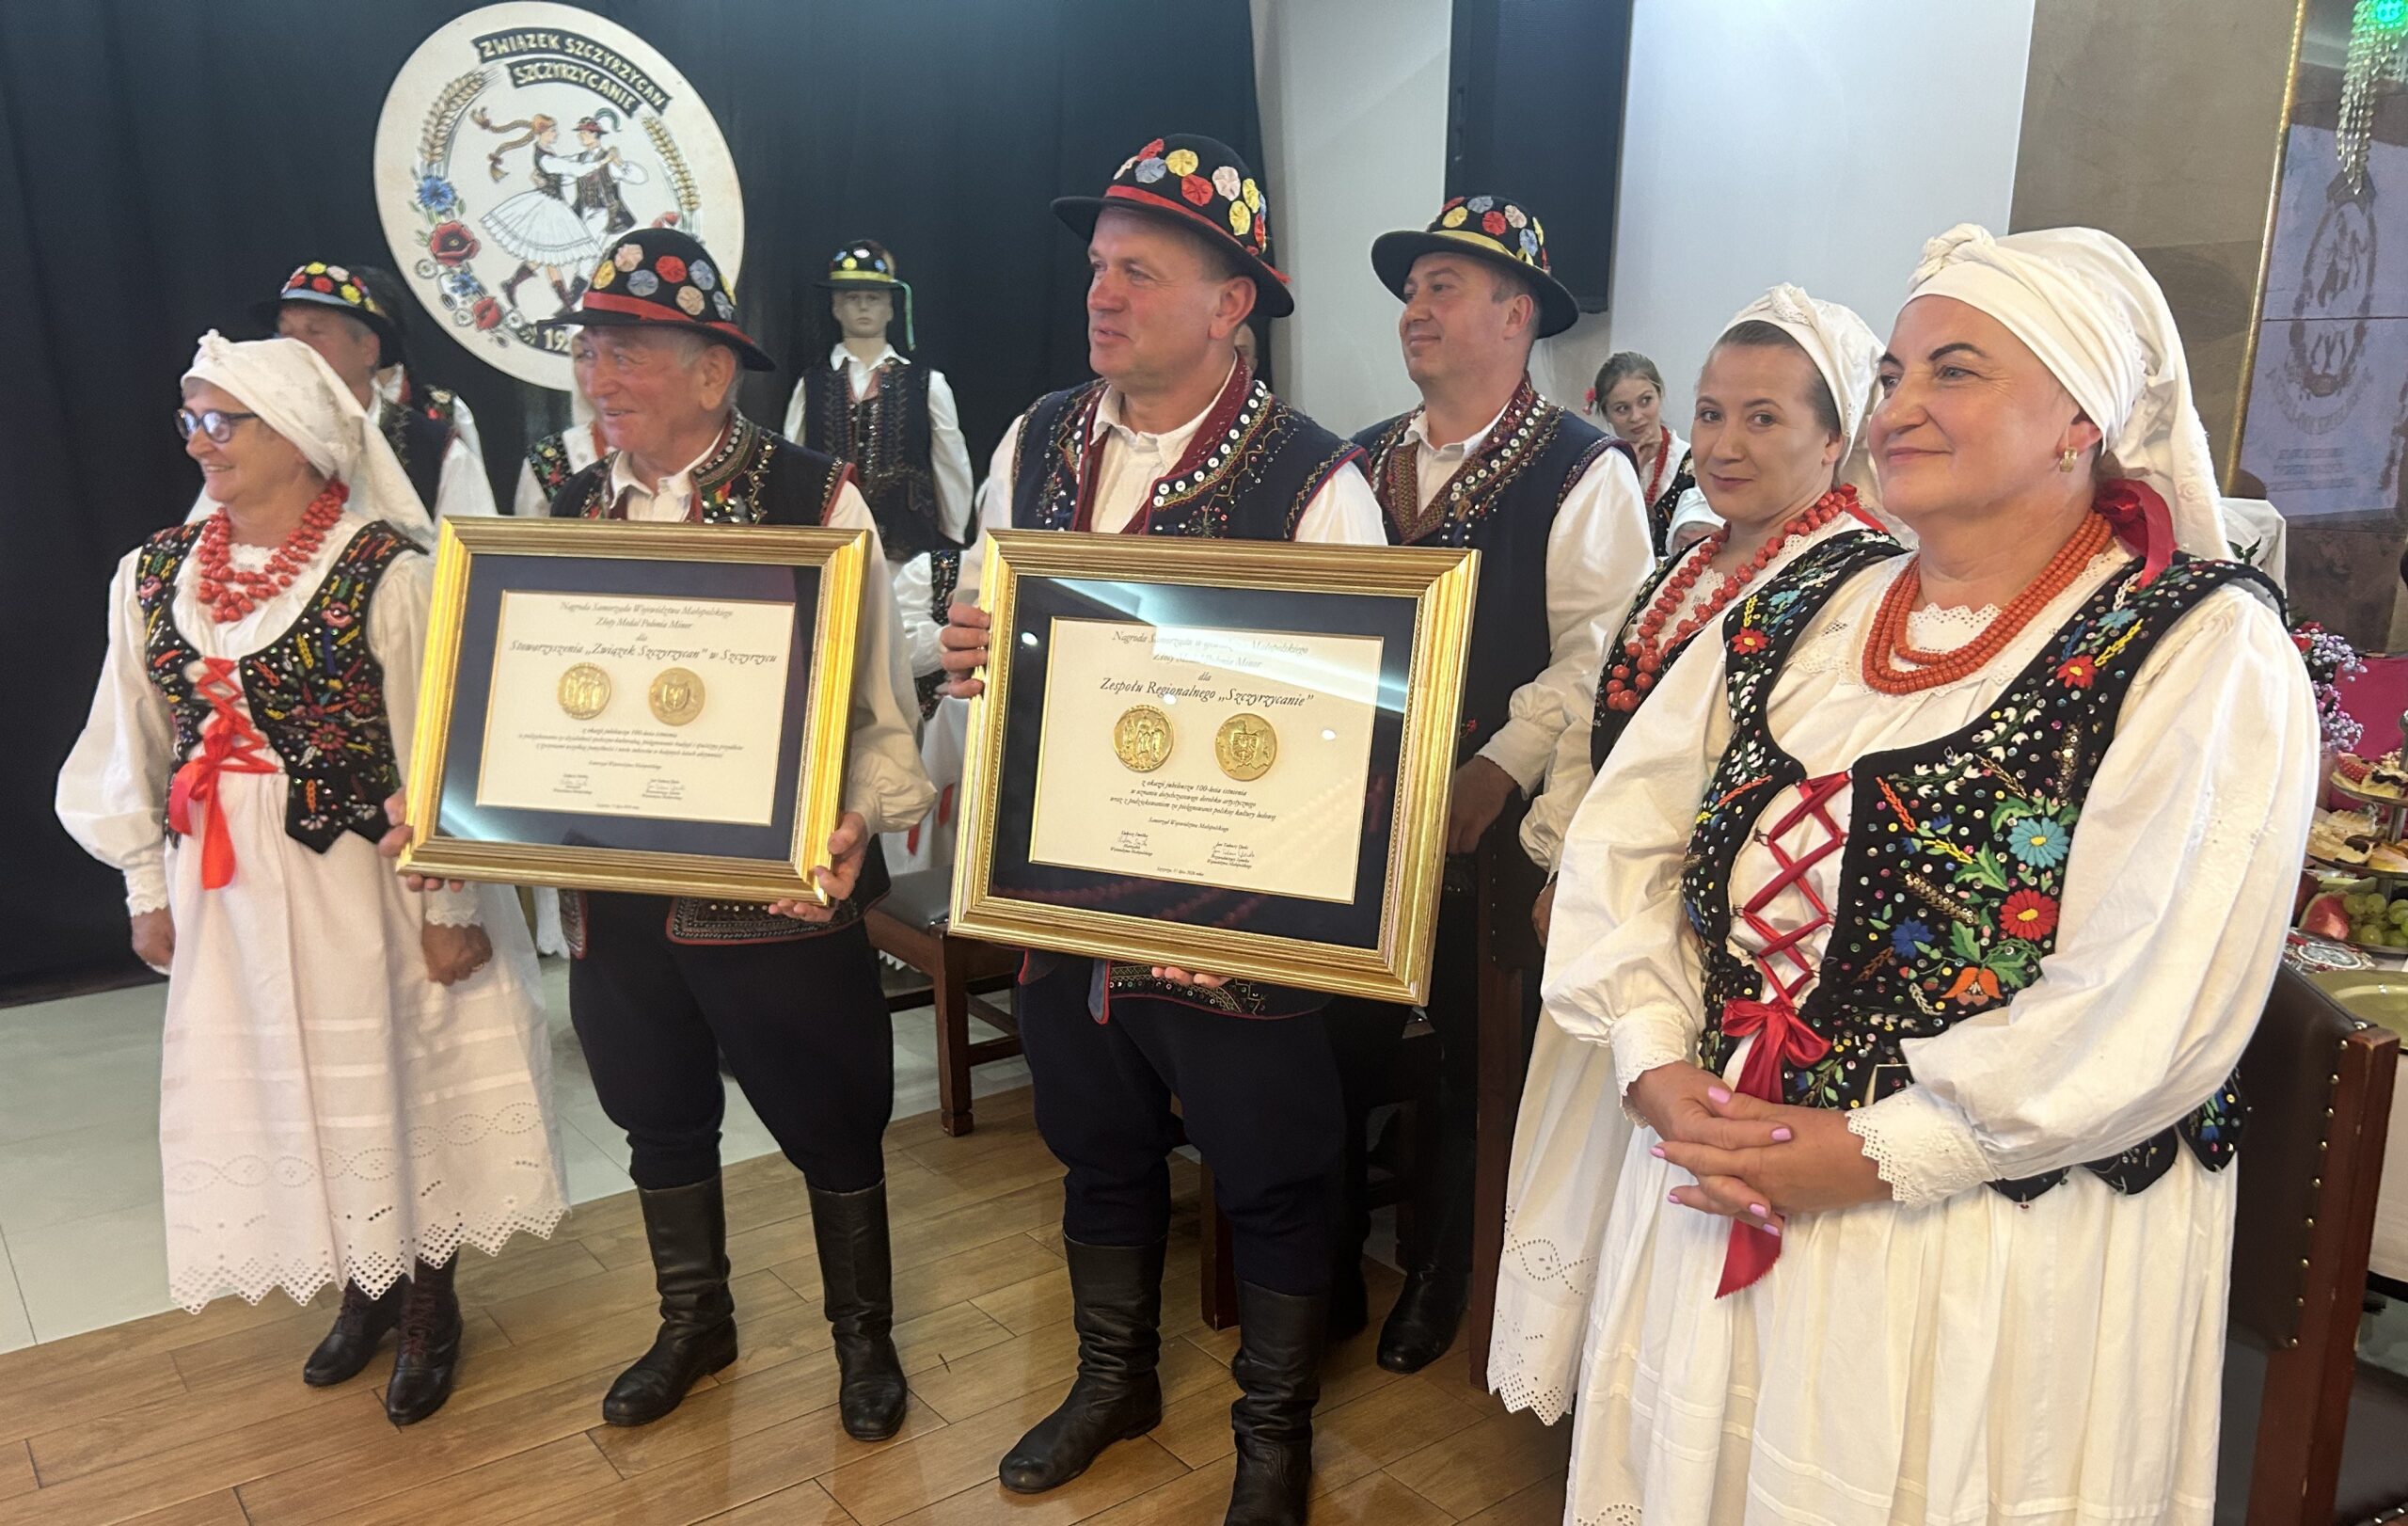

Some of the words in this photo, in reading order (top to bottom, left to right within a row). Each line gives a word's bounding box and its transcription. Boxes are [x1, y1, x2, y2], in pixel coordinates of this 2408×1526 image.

[479, 33, 561, 57] ZWIĄZEK
[564, 37, 666, 105] SZCZYRZYCAN
[513, 62, 636, 109] SZCZYRZYCANIE
[1112, 630, 1148, 644] Nagroda
[509, 640, 583, 657] Stowarzyszenia
[720, 648, 777, 665] Szczyrzycu
[1197, 671, 1212, 681] dla
[1099, 677, 1144, 696] Zespołu
[1146, 680, 1216, 703] Regionalnego
[1217, 687, 1313, 710] „Szczyrzycanie”
